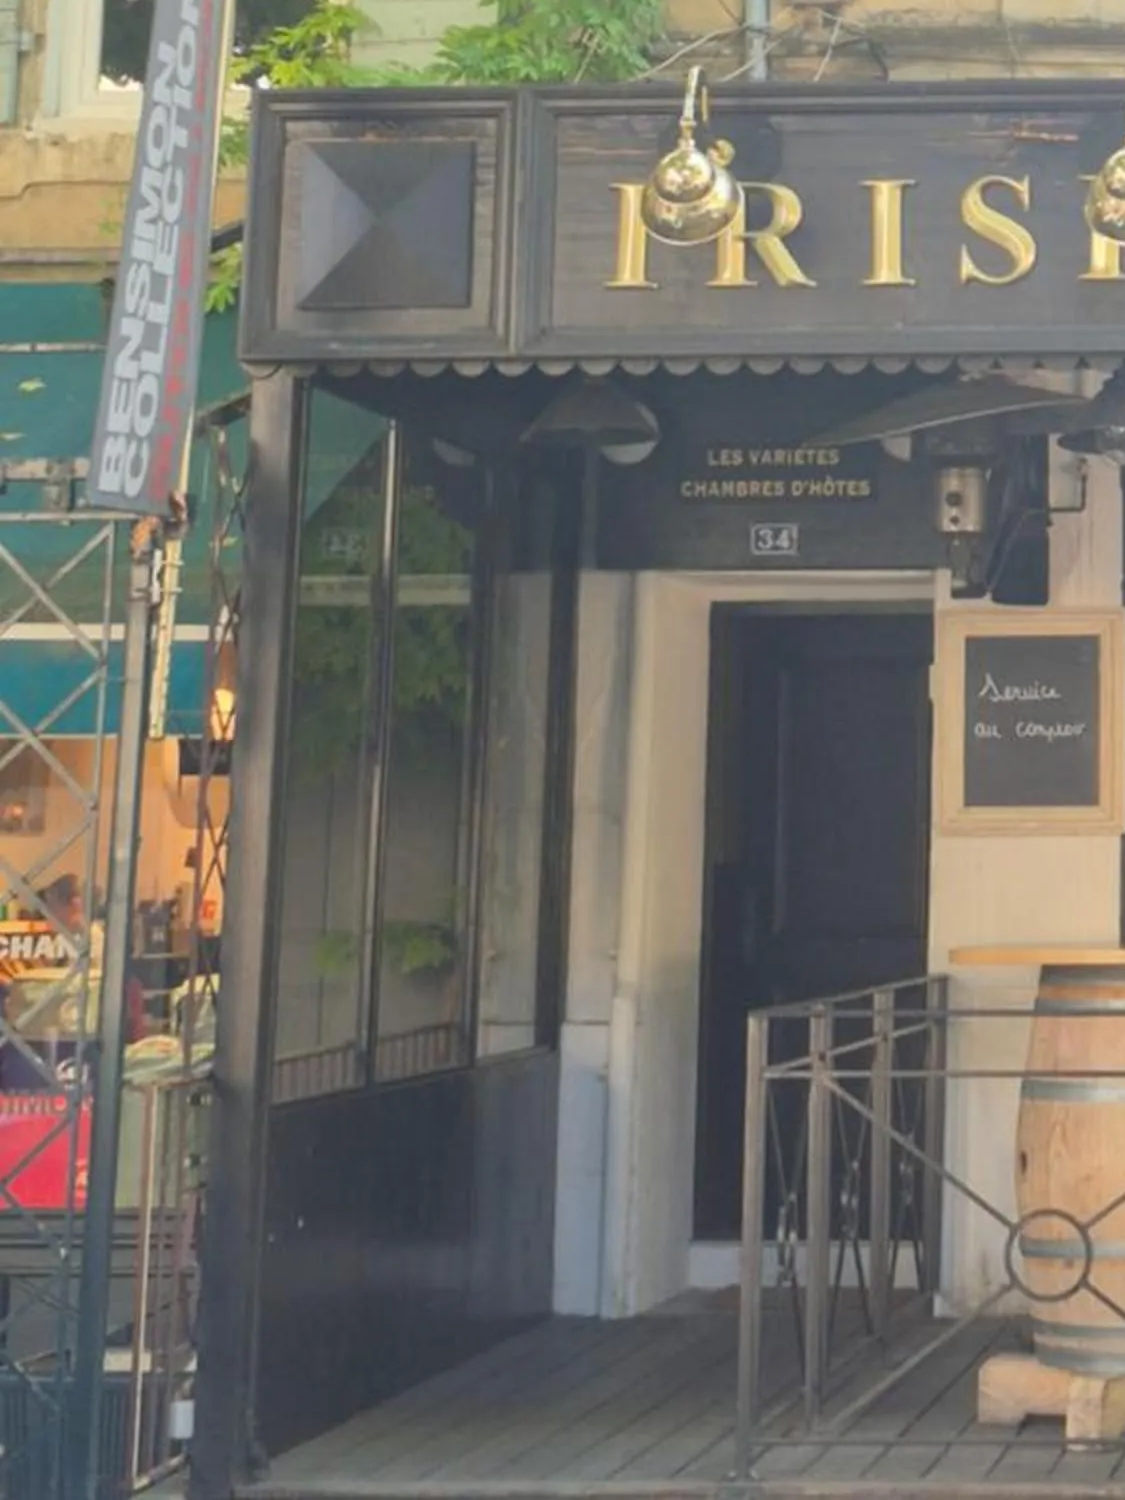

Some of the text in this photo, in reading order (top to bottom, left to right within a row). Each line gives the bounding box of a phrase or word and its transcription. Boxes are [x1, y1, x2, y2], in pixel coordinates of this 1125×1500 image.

[98, 40, 177, 495] BENSIMON
[707, 449, 744, 466] LES
[680, 475, 871, 497] CHAMBRES D'HÔTES
[757, 528, 791, 550] 34
